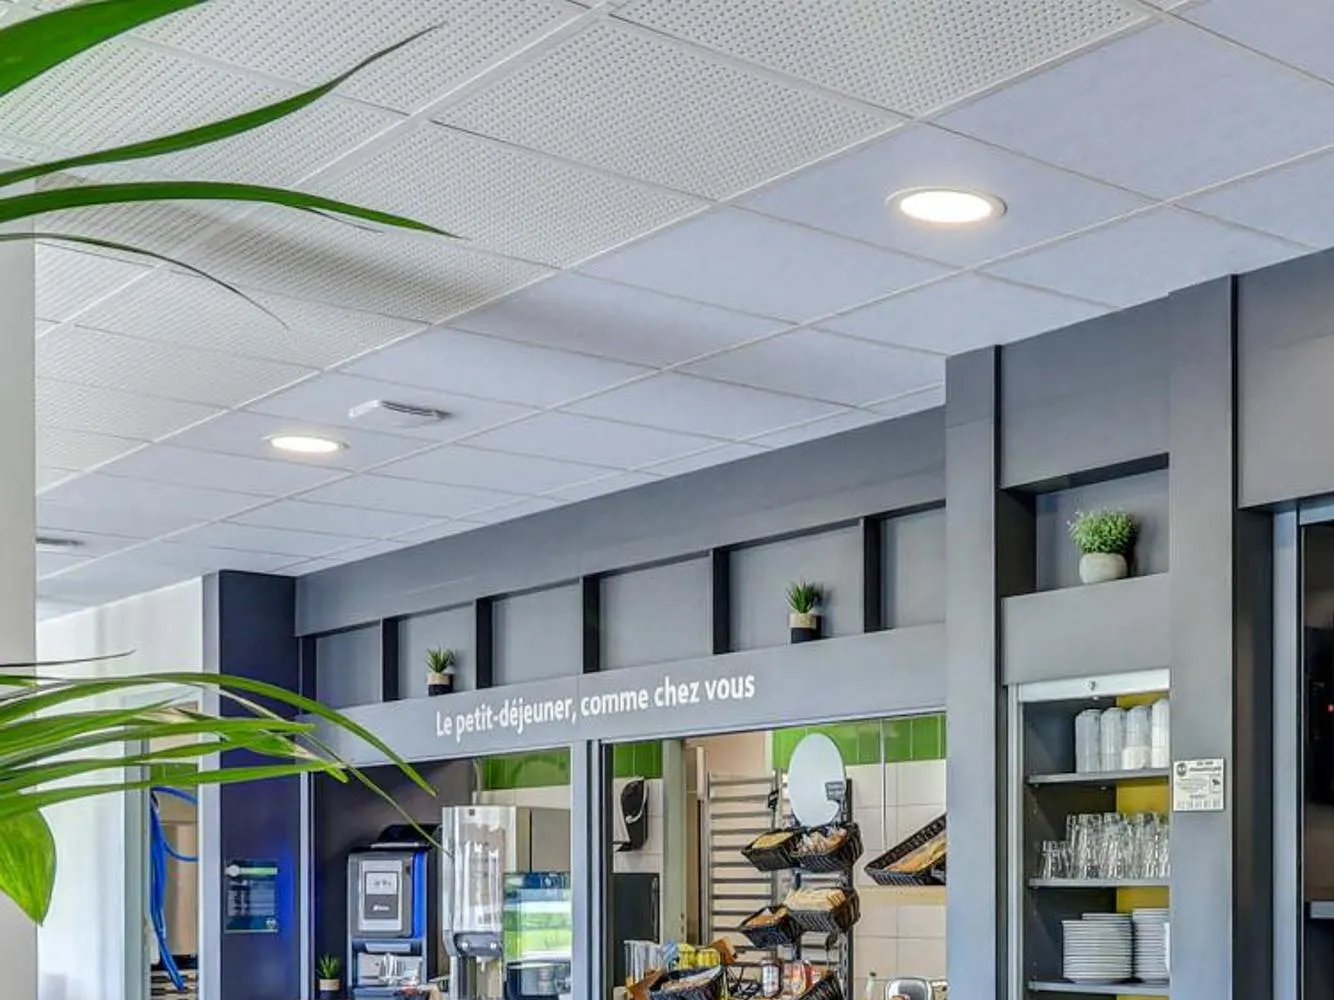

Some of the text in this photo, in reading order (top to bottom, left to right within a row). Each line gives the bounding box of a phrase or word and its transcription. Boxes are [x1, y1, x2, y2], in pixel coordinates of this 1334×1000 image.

[436, 674, 756, 743] Le petit-déjeuner, comme chez vous
